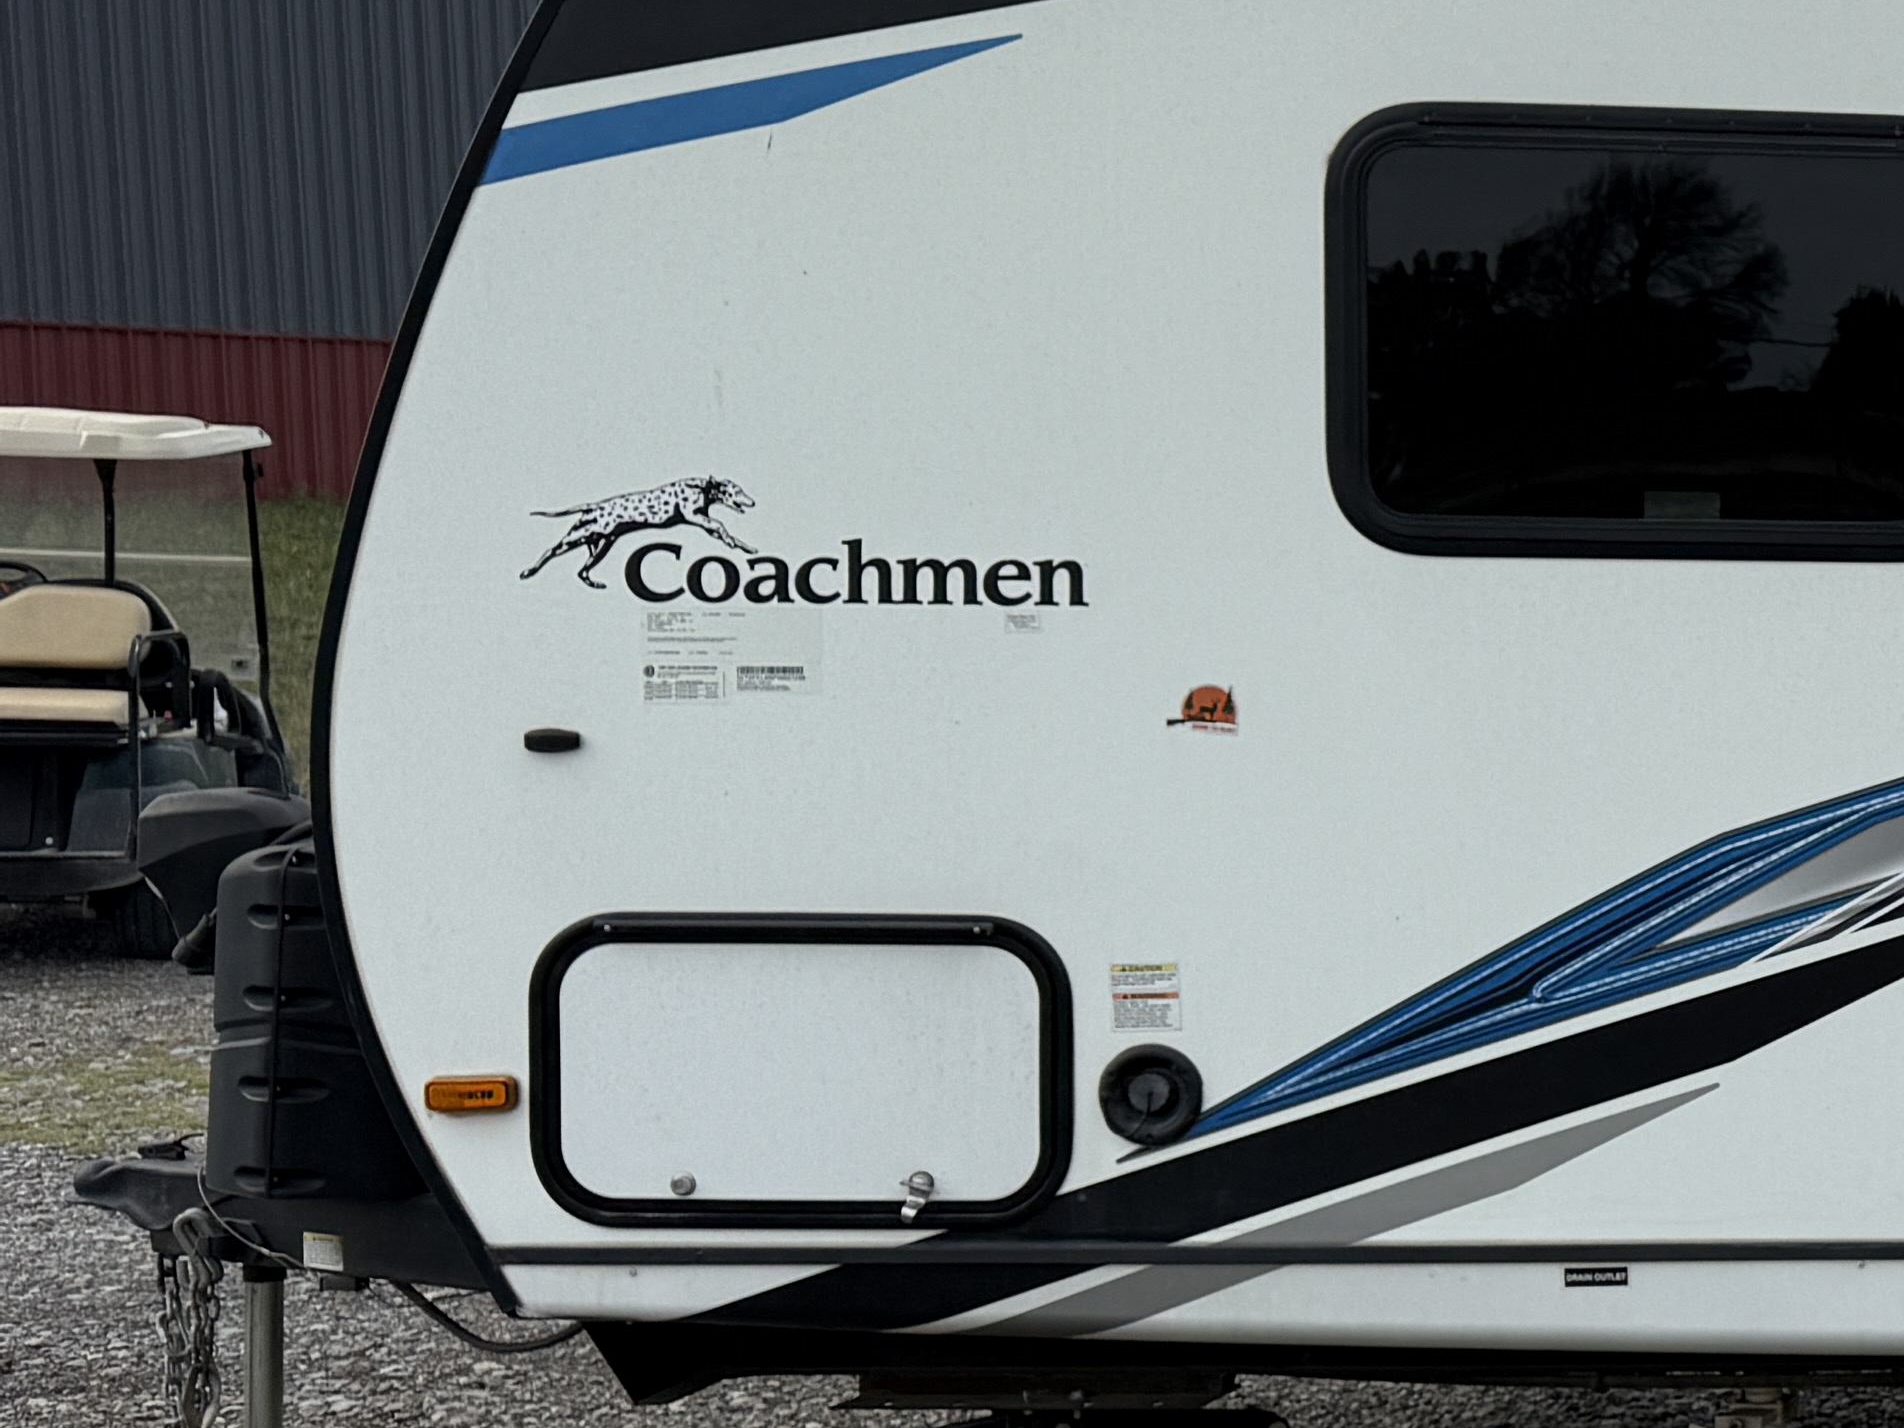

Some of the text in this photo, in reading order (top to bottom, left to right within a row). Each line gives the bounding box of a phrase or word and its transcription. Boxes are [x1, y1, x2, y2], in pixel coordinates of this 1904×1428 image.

[624, 538, 1089, 607] Coachmen
[1566, 1271, 1627, 1282] DRAIN OUTLET
